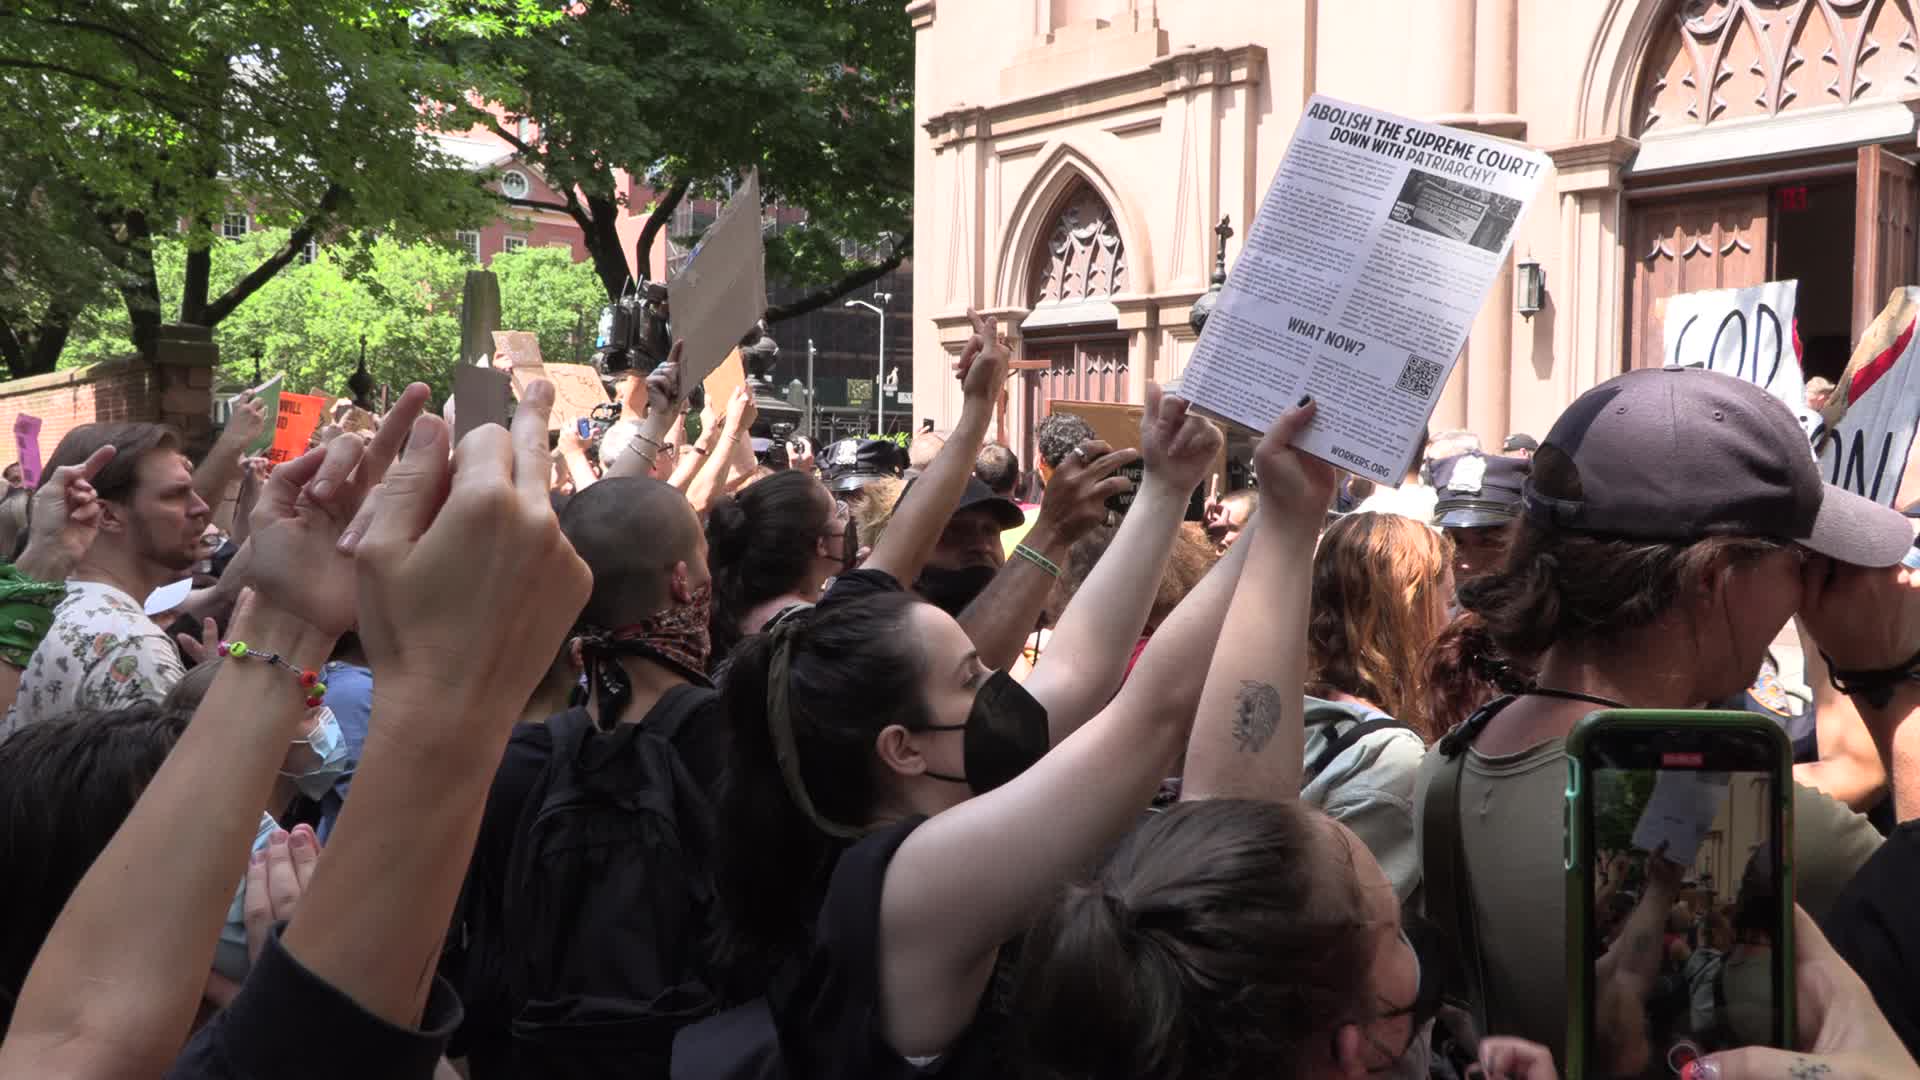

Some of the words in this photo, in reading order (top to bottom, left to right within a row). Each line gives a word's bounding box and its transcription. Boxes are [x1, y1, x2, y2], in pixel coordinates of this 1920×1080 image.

[1308, 103, 1373, 132] ABOLISH
[1374, 119, 1404, 141] THE
[1403, 128, 1475, 160] SUPREME
[1476, 148, 1540, 180] COURT!
[1329, 126, 1371, 149] DOWN
[1371, 138, 1405, 159] WITH
[1405, 148, 1497, 185] PATRIARCHY!
[1288, 316, 1326, 341] WHAT
[1324, 331, 1366, 356] NOW?
[1330, 444, 1391, 477] WORKERS.ORG
